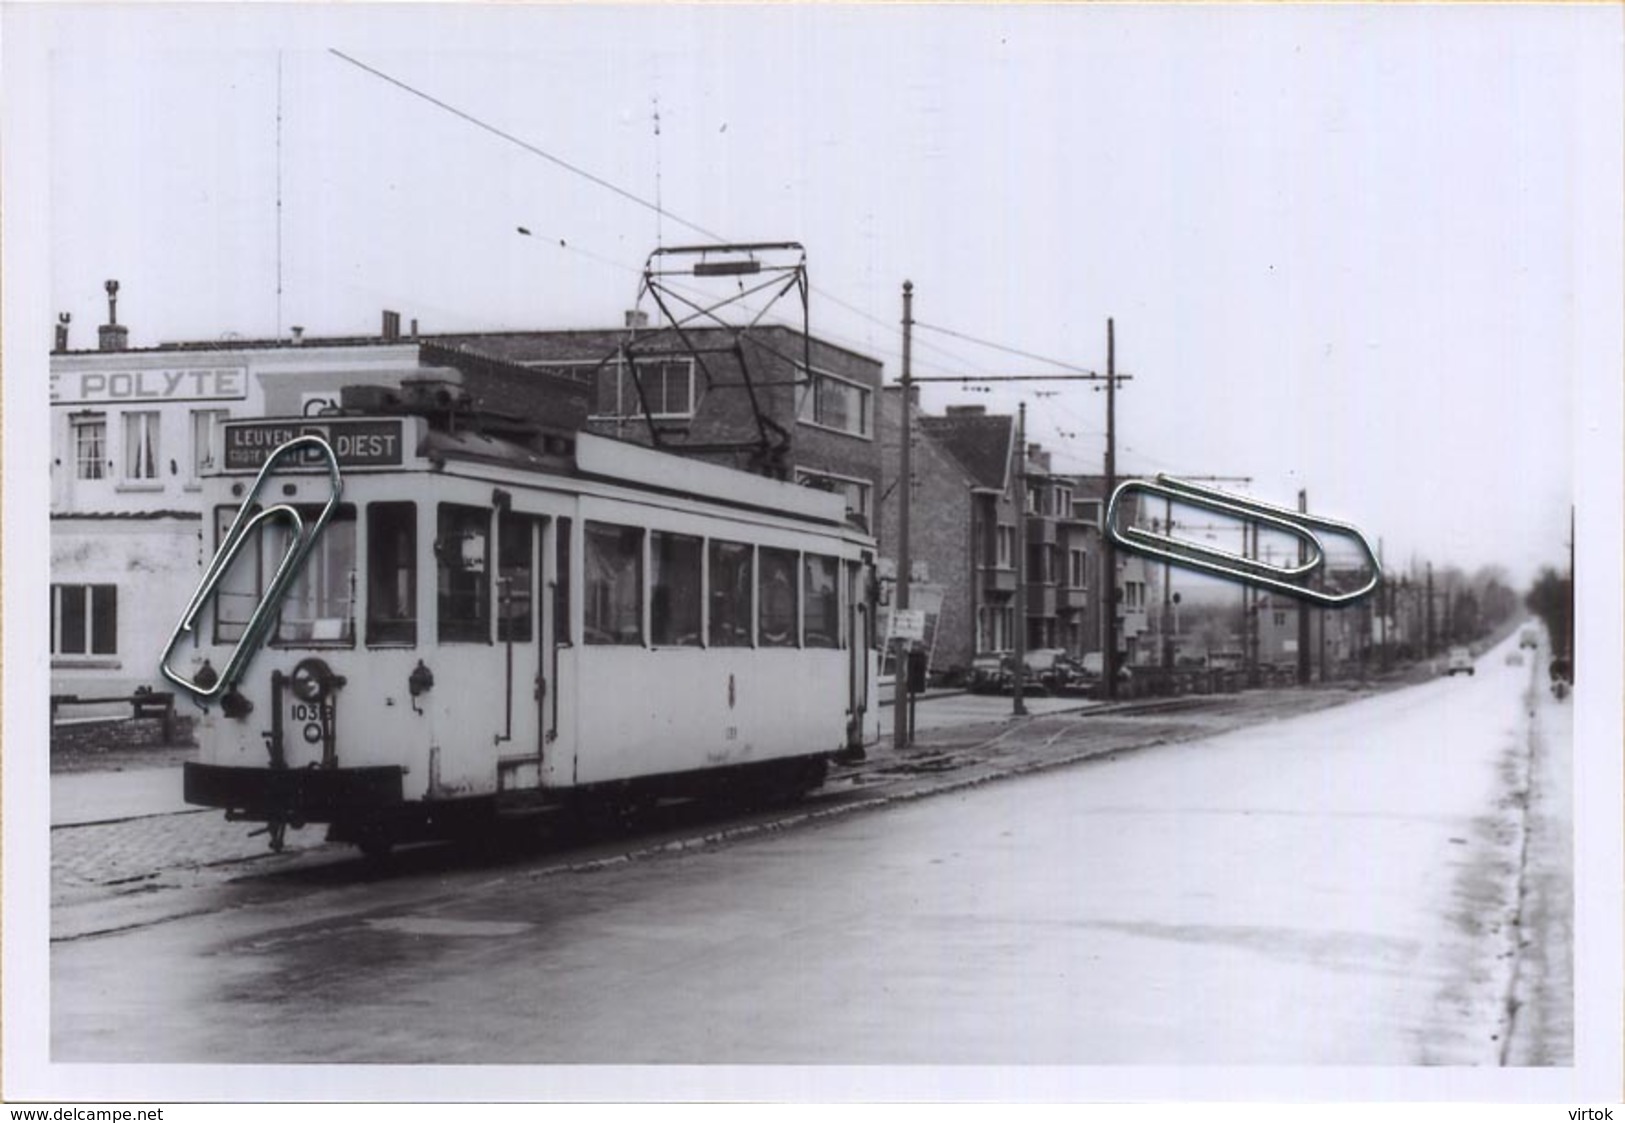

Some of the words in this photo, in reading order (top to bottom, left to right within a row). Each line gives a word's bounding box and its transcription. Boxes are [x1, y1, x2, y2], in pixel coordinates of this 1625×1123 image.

[80, 370, 240, 399] POLYTE
[234, 429, 293, 447] LEUVEN
[337, 434, 396, 457] DIEST
